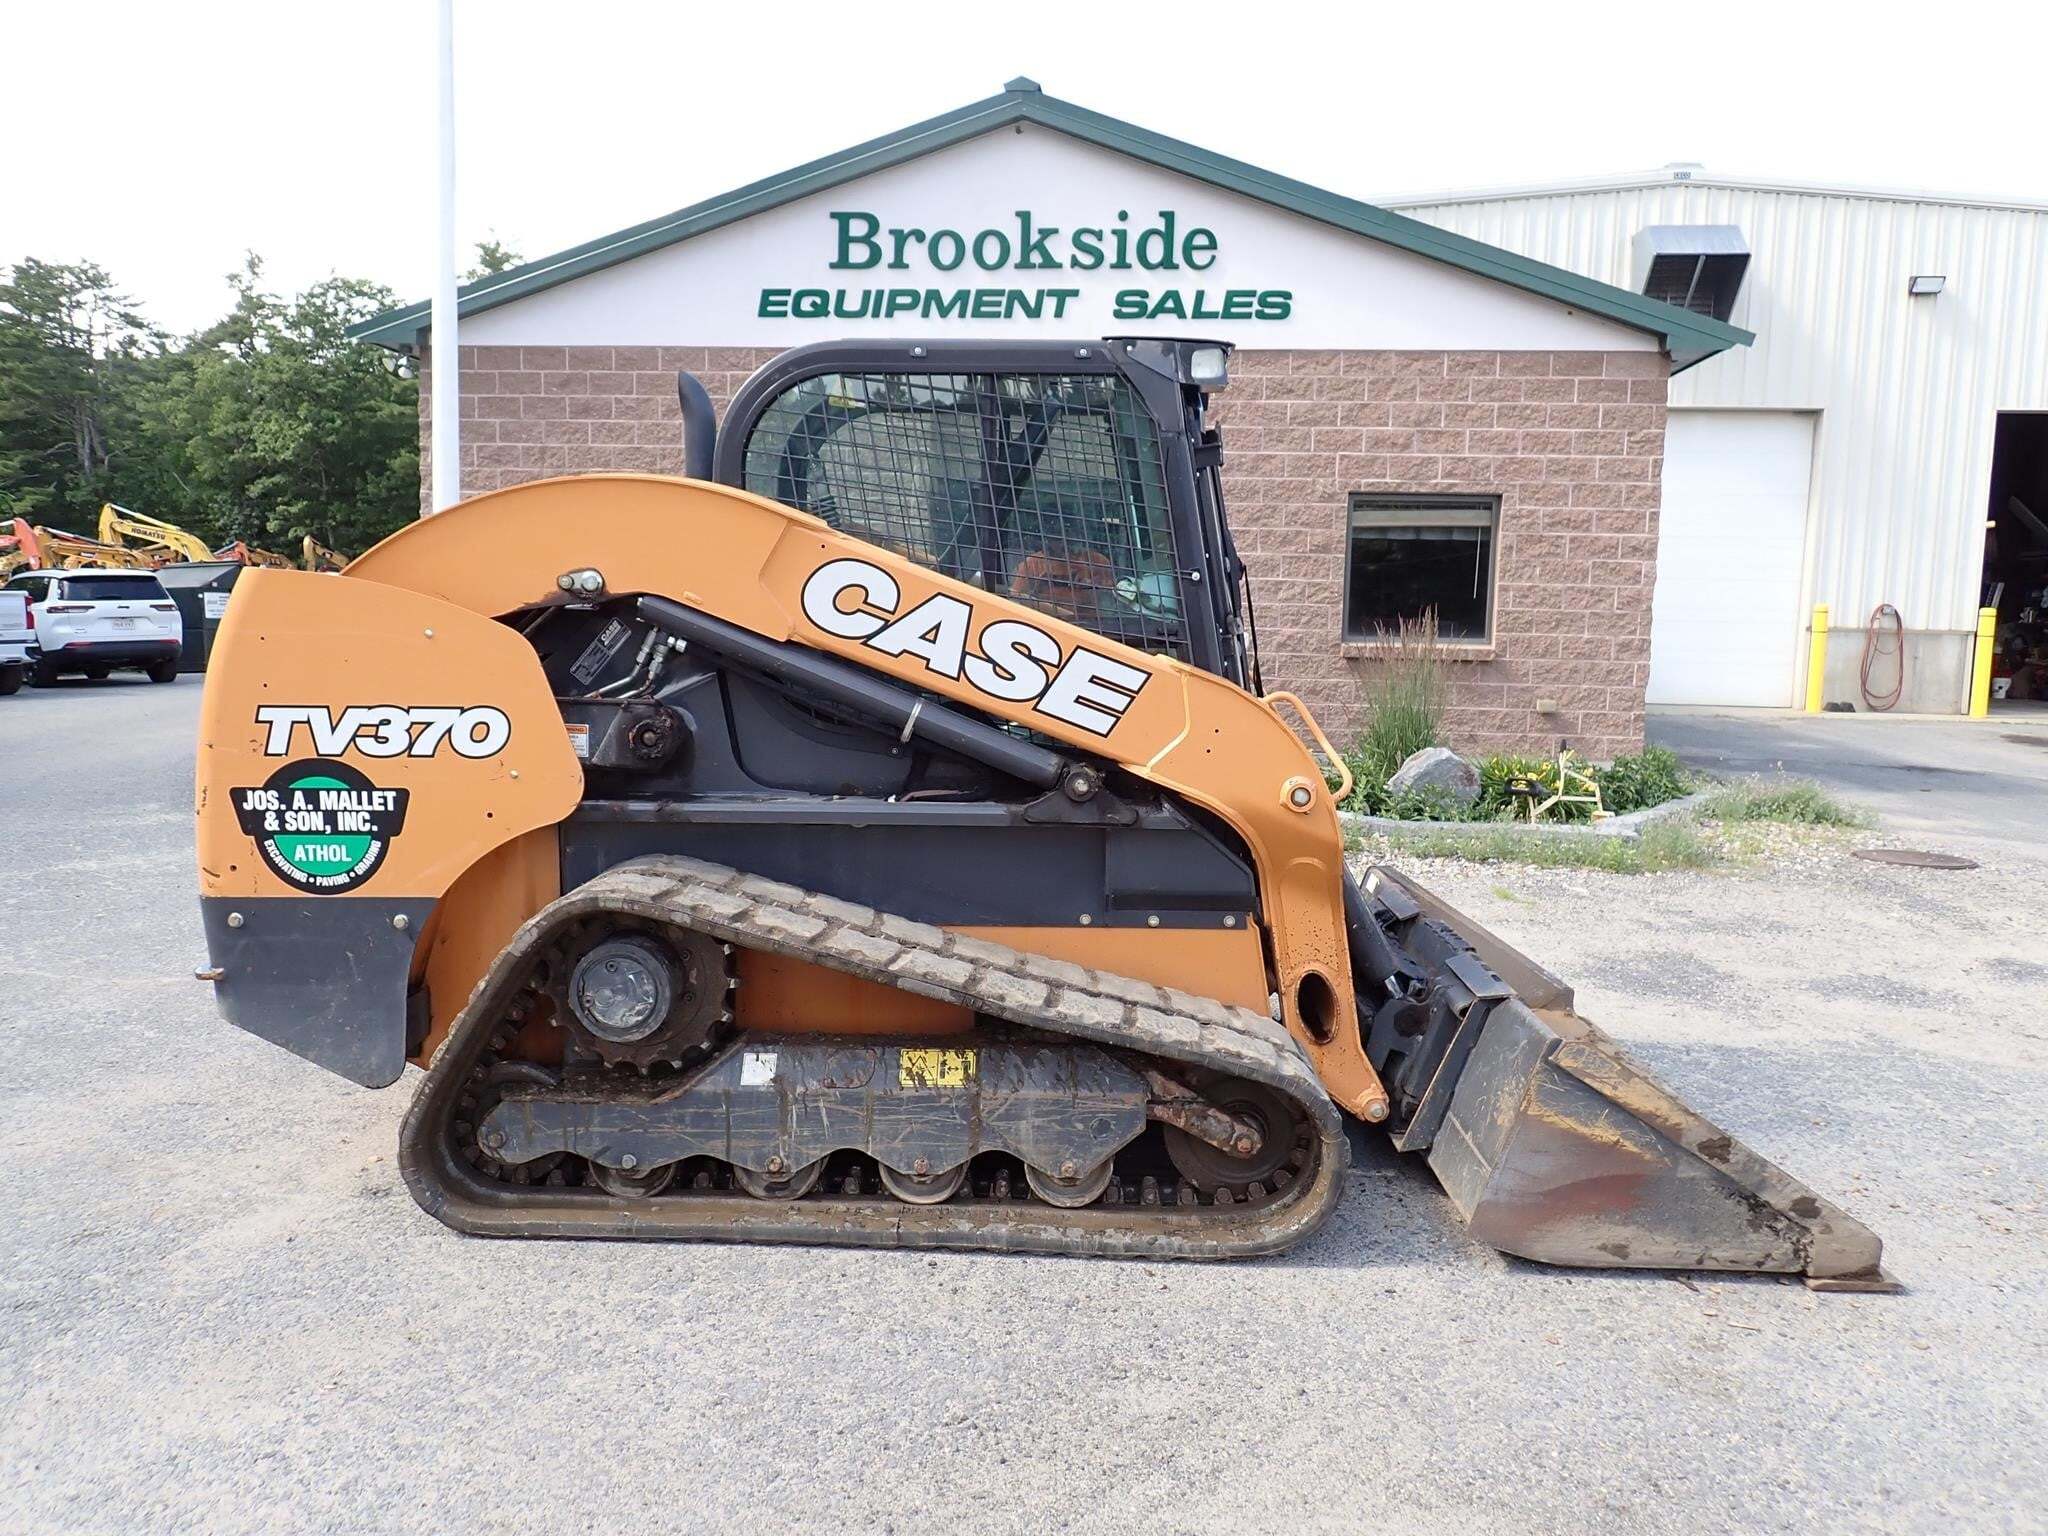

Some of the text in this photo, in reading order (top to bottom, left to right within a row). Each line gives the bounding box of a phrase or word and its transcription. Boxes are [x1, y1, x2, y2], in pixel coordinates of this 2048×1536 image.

[829, 210, 1218, 271] Brookside
[758, 288, 1293, 320] EQUIPMENT SALES
[801, 558, 1153, 738] CASE
[255, 704, 511, 759] TV370
[242, 789, 397, 812] JOS. A. MALLET
[264, 811, 379, 834] & SON, INC.
[263, 838, 382, 888] EXCAVATING PAVING GRADING
[294, 844, 353, 863] ATHOL
